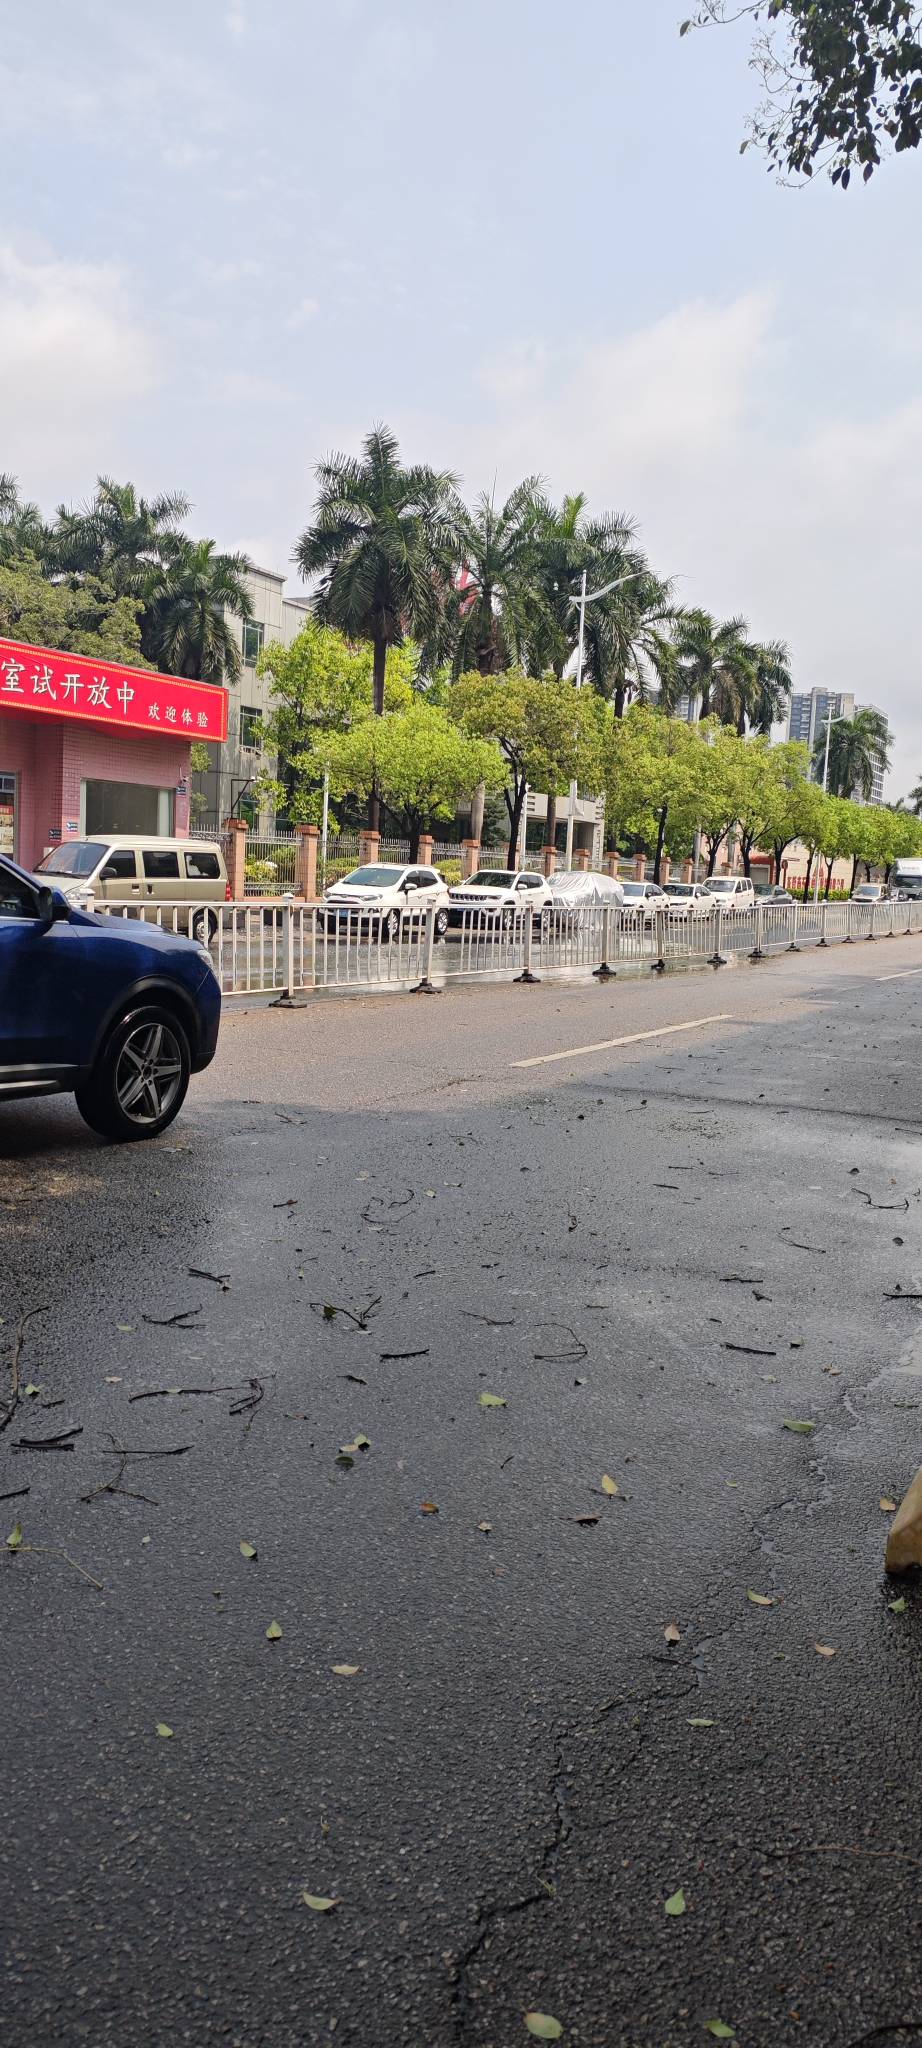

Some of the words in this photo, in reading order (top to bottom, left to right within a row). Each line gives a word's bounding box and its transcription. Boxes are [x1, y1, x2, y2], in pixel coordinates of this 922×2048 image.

[1, 658, 135, 715] 室试开放中
[148, 702, 208, 728] 欢迎体验
